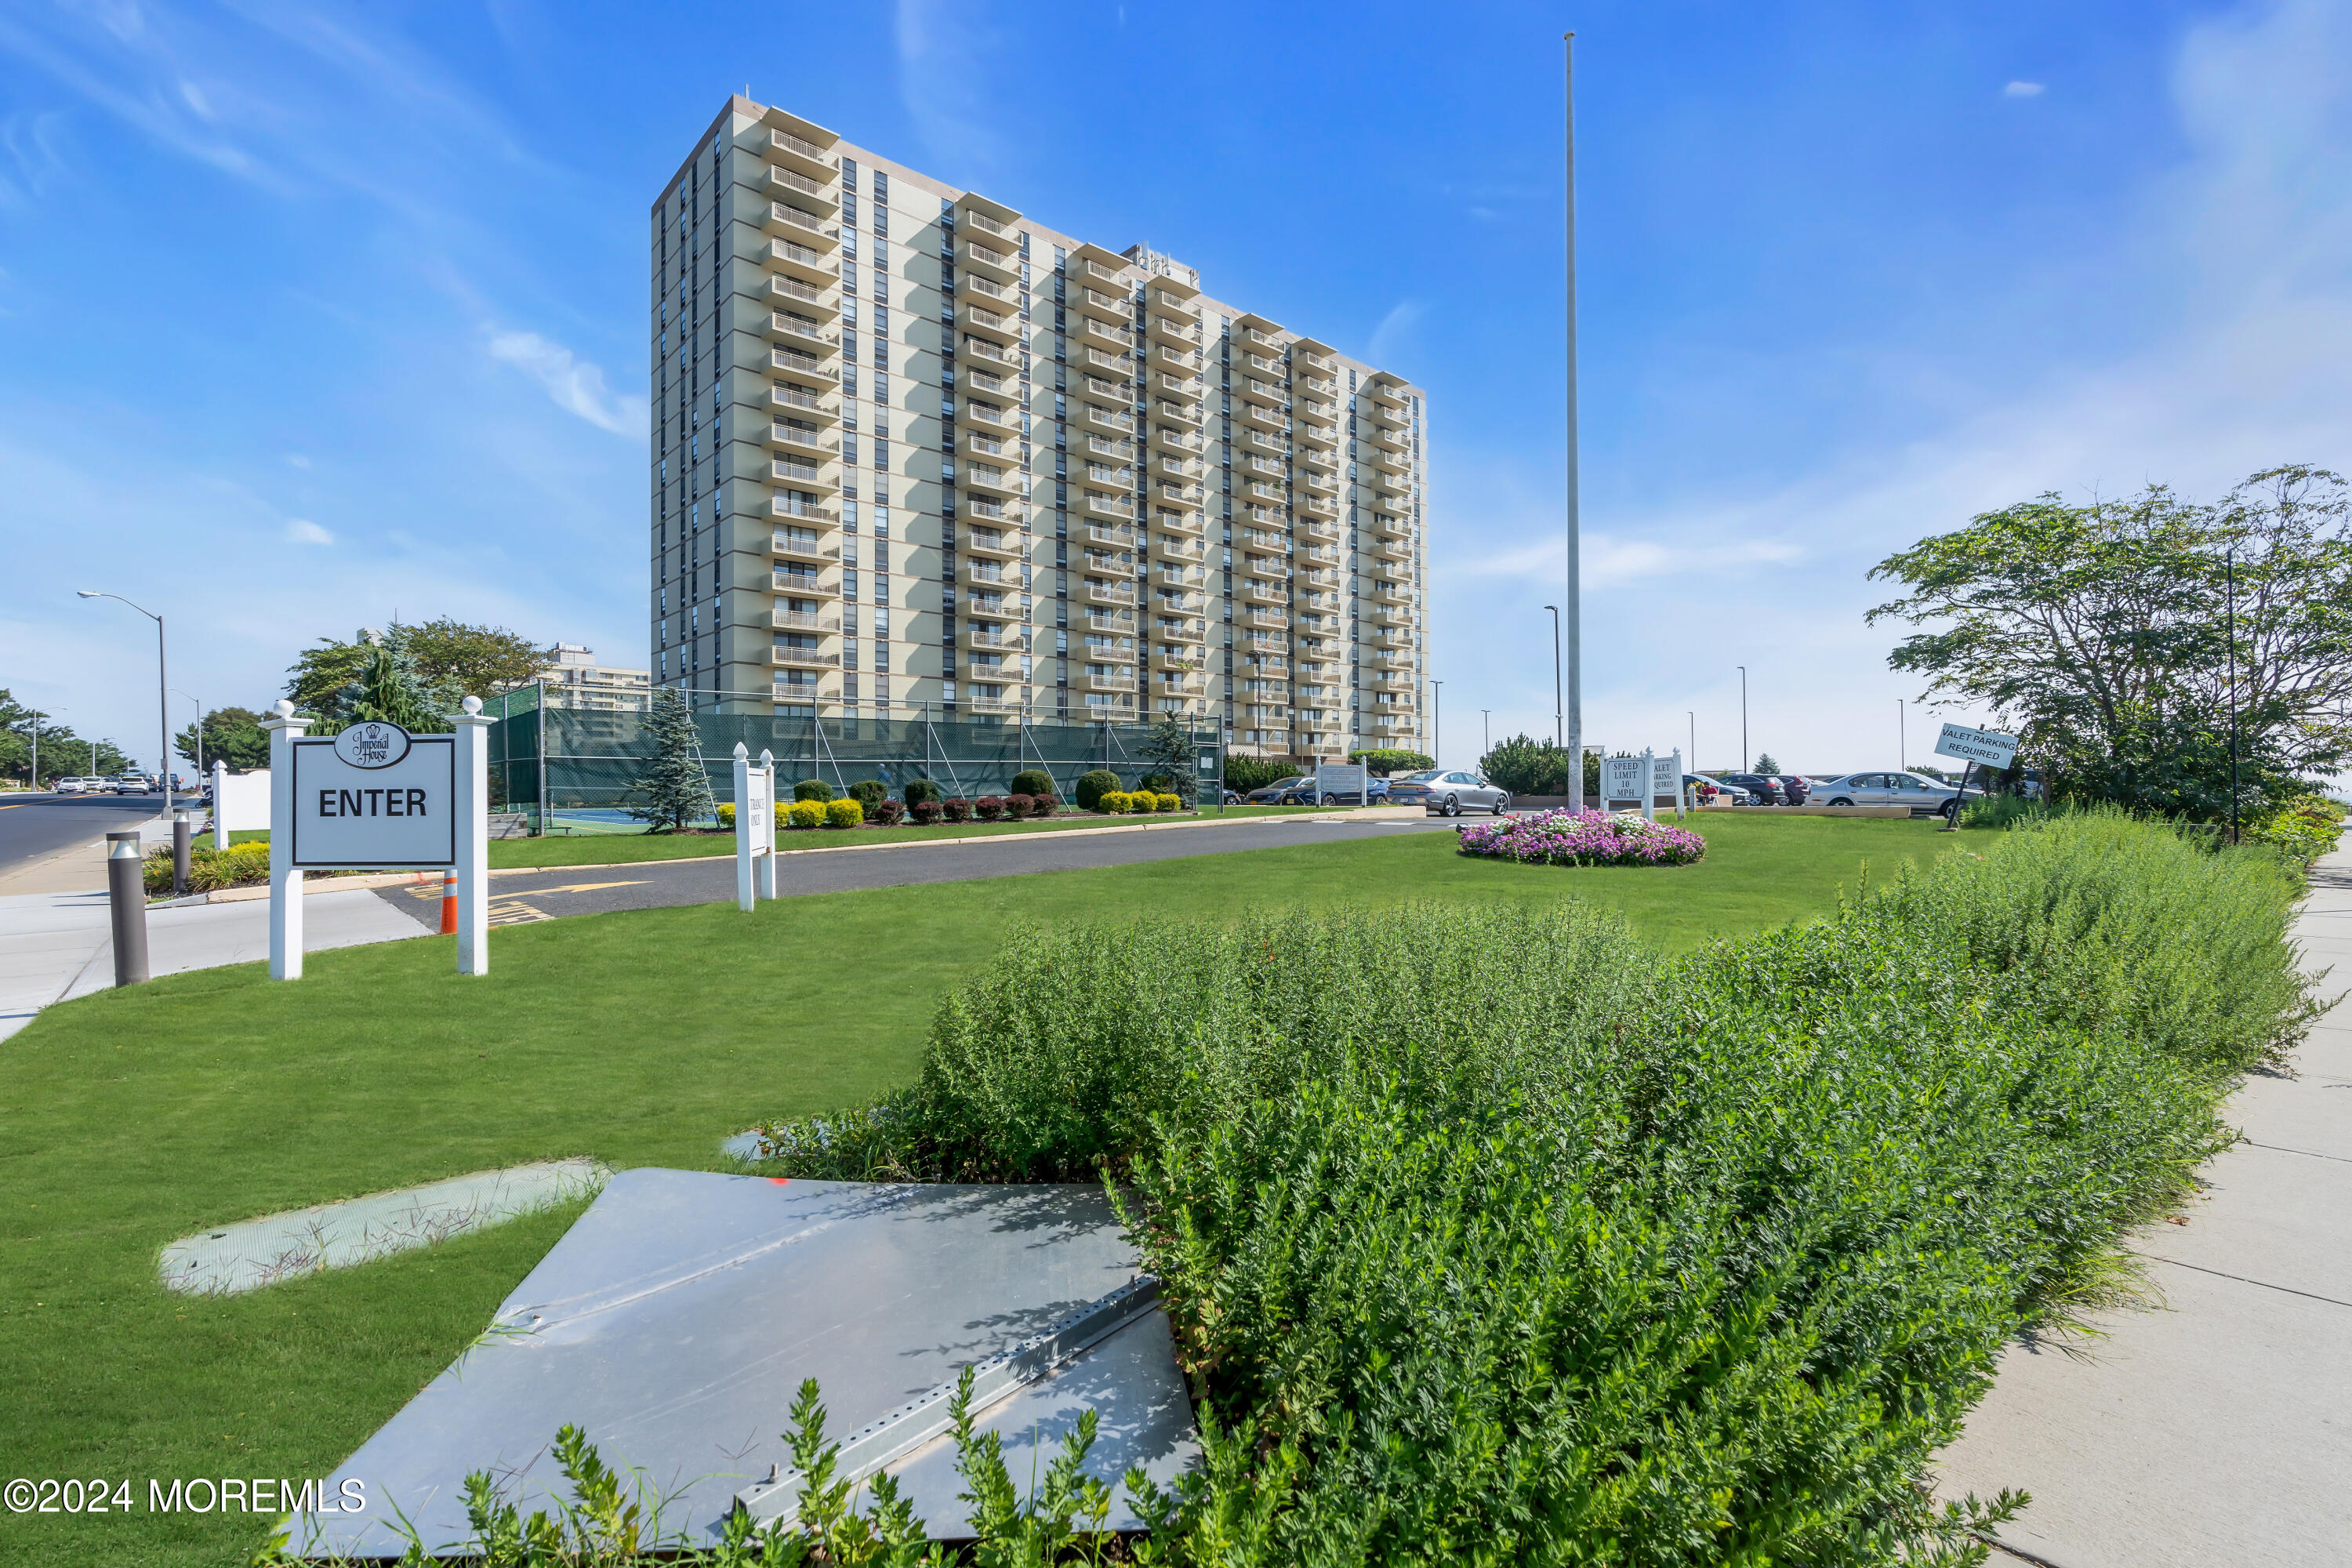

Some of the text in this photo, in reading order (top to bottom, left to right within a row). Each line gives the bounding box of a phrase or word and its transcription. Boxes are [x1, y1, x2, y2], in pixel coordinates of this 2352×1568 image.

[352, 731, 390, 756] Imperial
[1942, 727, 2016, 750] VALET PARKING
[357, 746, 387, 766] House
[1948, 742, 2000, 760] REQUIRED
[1613, 762, 1639, 771] SPEED
[1654, 764, 1670, 772] ALET
[1614, 771, 1638, 779] LIMIT
[1654, 781, 1674, 789] QUIRED
[319, 788, 427, 817] ENTER
[750, 798, 764, 810] TRANCE
